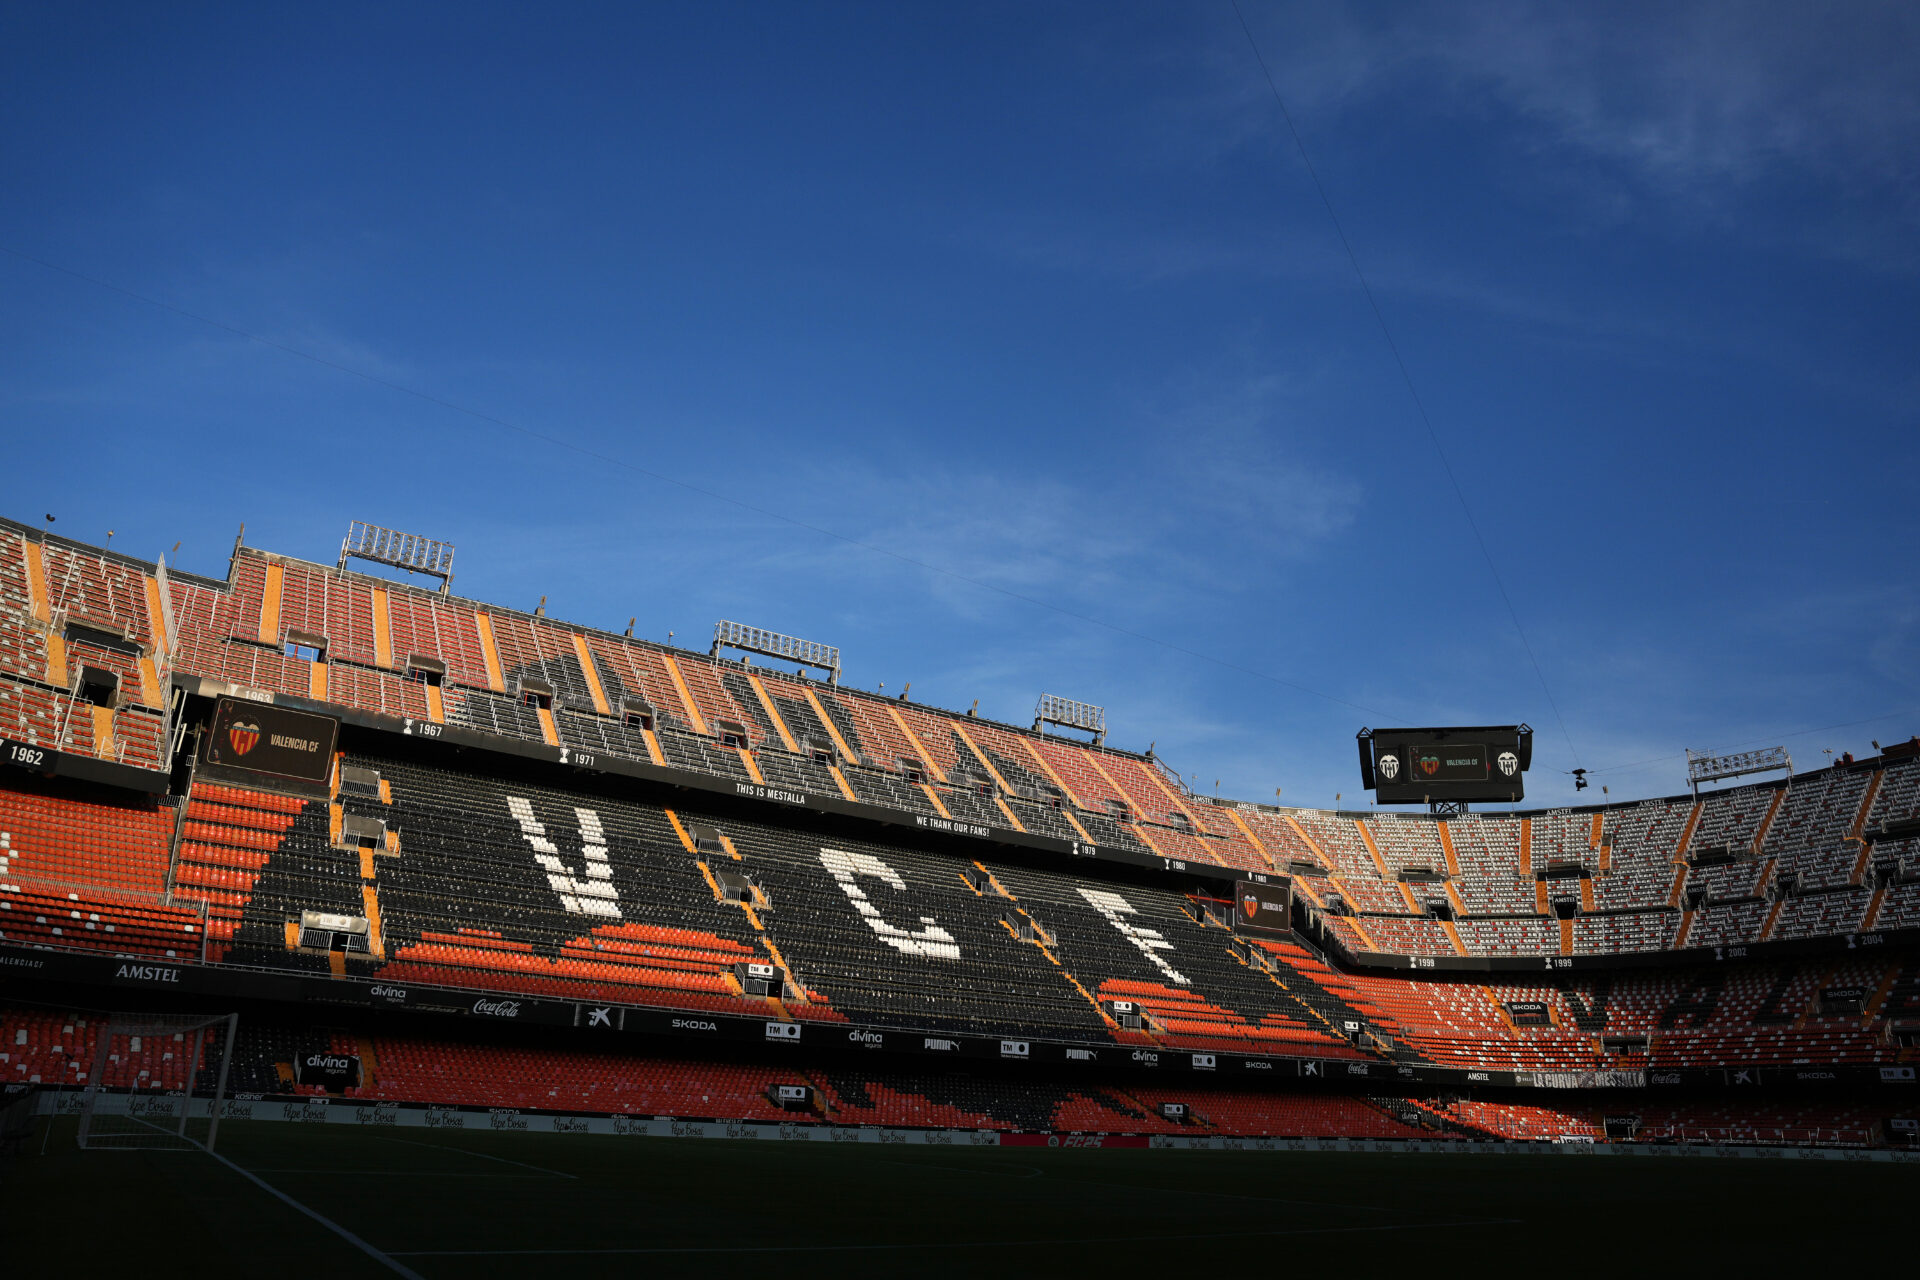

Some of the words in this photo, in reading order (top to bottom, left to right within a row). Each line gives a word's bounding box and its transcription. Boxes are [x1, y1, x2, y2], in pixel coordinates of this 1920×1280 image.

[418, 723, 442, 736] 1967
[270, 734, 307, 750] VALENCIA
[308, 741, 319, 753] CF
[11, 746, 43, 765] 1962
[574, 753, 595, 766] 1971
[736, 783, 754, 795] THIS
[756, 787, 764, 797] IS
[767, 789, 805, 804] MESTALLA
[916, 815, 927, 826] WE
[929, 817, 952, 830] THANK
[953, 822, 968, 834] OUR
[970, 825, 990, 837] FANS!
[1081, 845, 1096, 855] 1979
[1173, 861, 1185, 870] 1980
[1862, 935, 1883, 945] 2004
[1728, 947, 1748, 958] 2002
[1419, 959, 1435, 967] 1999
[1555, 958, 1573, 967] 1999
[116, 964, 179, 983] AMSTEL
[370, 985, 407, 998] divina
[1826, 990, 1862, 998] SKODA
[769, 1026, 780, 1035] TM
[848, 1029, 882, 1043] divina
[924, 1038, 951, 1051] PUMA
[306, 1054, 348, 1069] divina
[1132, 1051, 1158, 1062] divina
[1245, 1061, 1272, 1069] SKODA
[1467, 1073, 1490, 1081] AMSTEL
[1545, 1073, 1579, 1088] CURVA
[1797, 1072, 1836, 1080] SKODA
